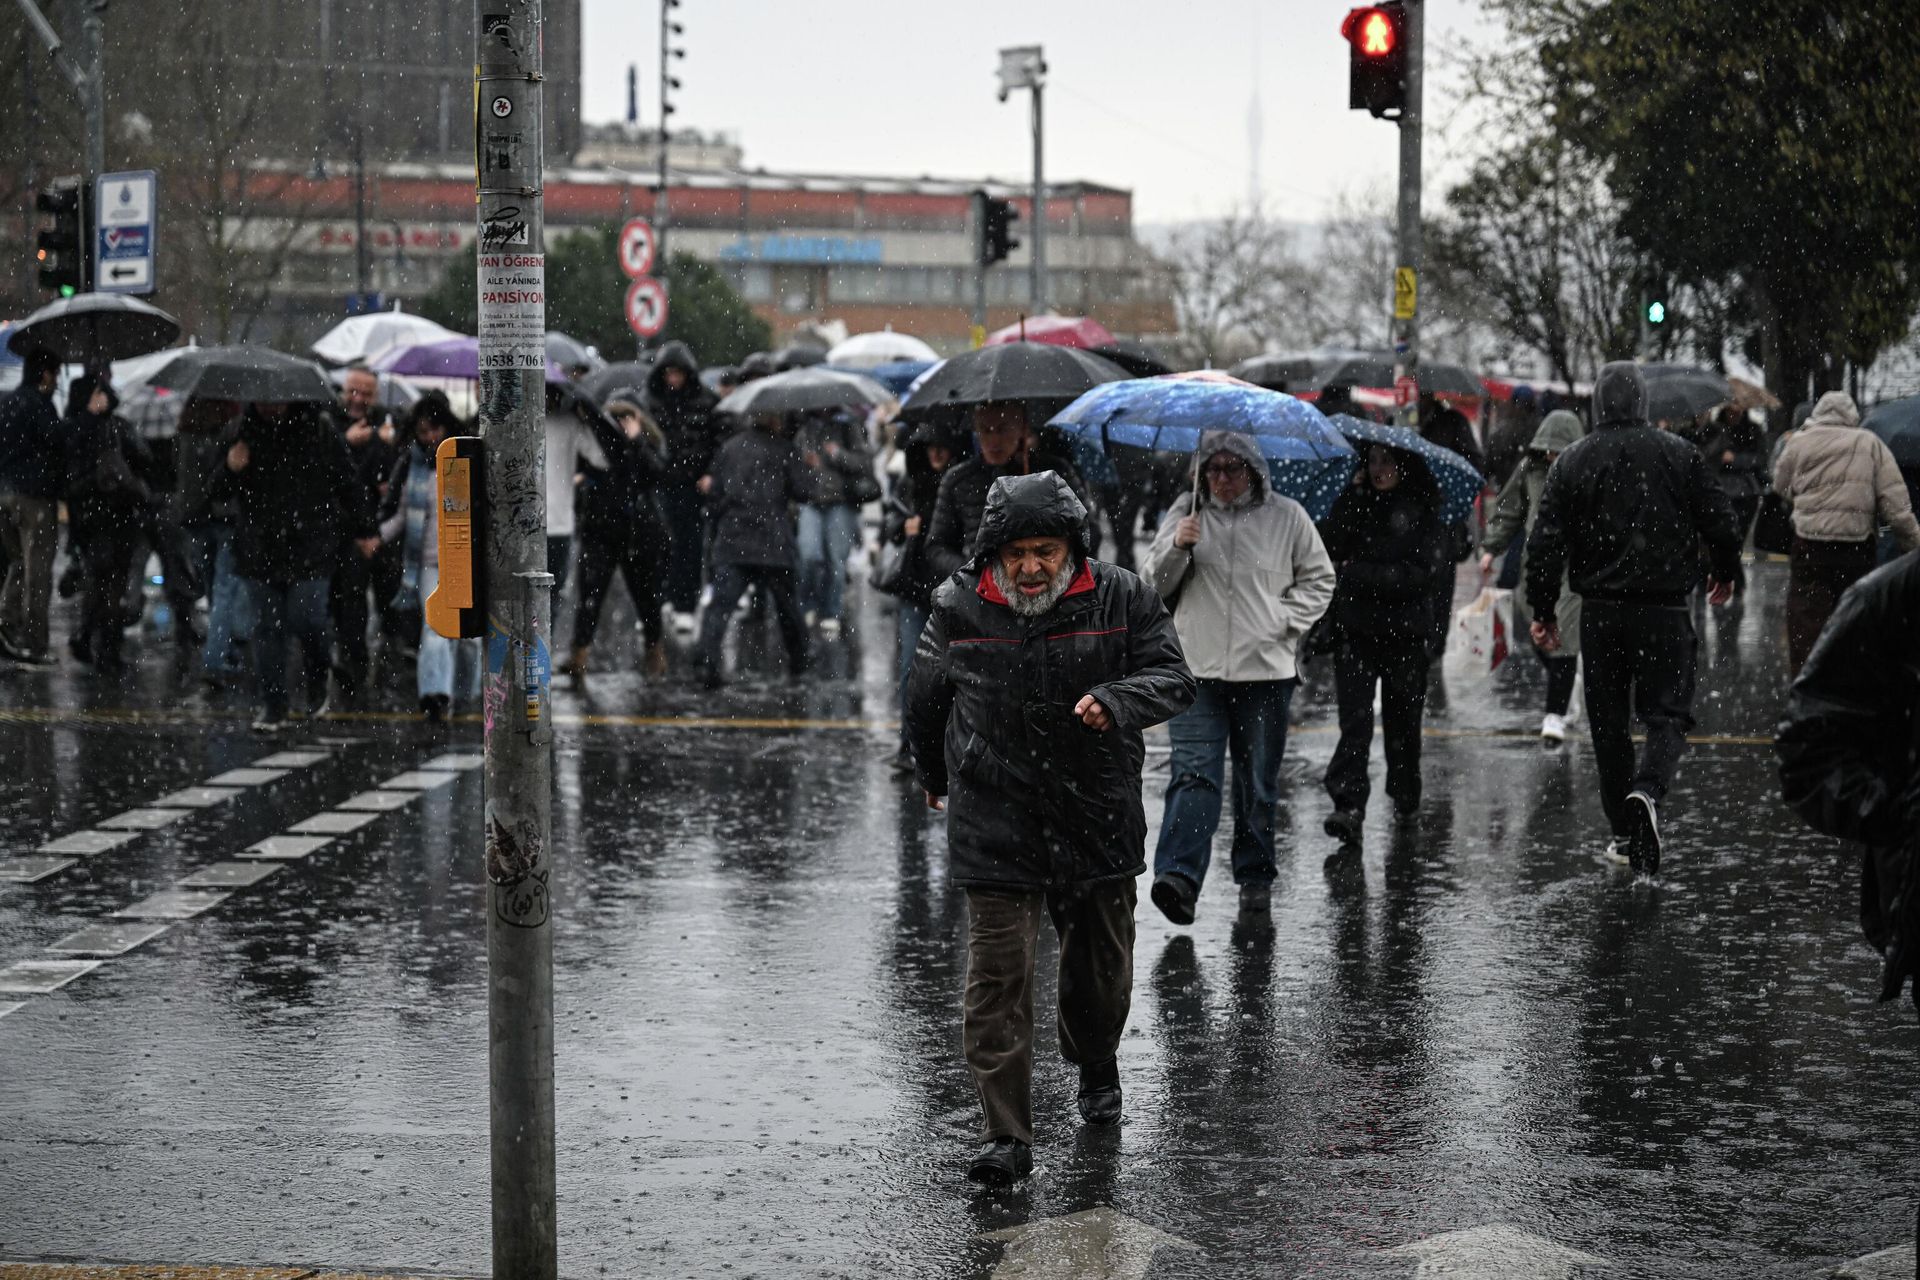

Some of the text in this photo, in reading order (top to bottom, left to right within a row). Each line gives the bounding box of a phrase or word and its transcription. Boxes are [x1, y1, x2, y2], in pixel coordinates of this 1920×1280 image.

[505, 277, 541, 285] YANINDA
[483, 290, 543, 304] PANSİYON
[485, 354, 514, 367] 0538
[518, 354, 538, 367] 706
